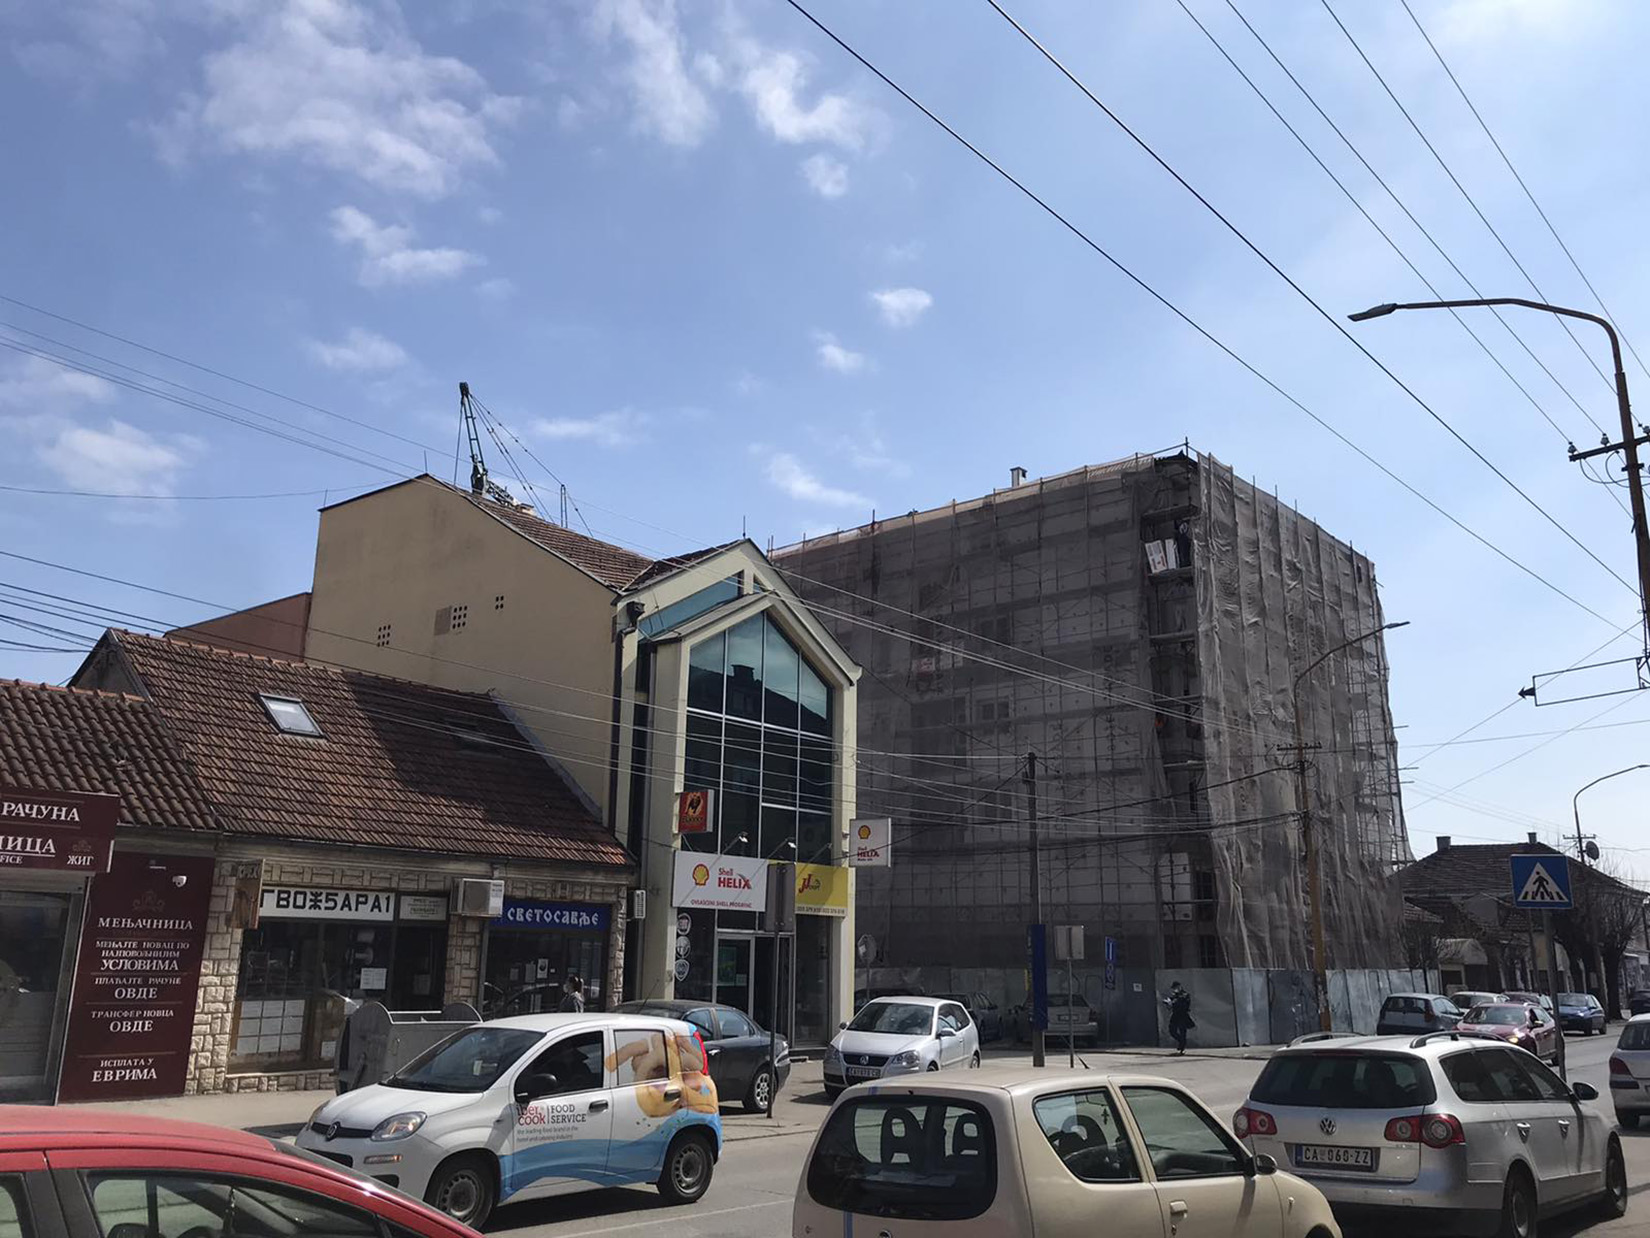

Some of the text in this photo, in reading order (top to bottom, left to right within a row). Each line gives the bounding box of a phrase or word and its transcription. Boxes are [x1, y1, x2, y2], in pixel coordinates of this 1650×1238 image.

[1, 801, 80, 821] РАЧУНА
[66, 855, 94, 866] ЖИГ
[718, 867, 734, 876] Shell
[717, 875, 752, 890] HELIX
[98, 917, 193, 930] МЕЊАЧНИЦА
[100, 959, 179, 971] УСЛОВИМА
[114, 987, 158, 1000] ОВДЕ
[91, 1010, 142, 1019] ТРАНСФЕР
[109, 1020, 154, 1033] ОВДЕ
[100, 1058, 145, 1068] ИСПЛАТА
[91, 1068, 157, 1083] ЕВРИМА
[551, 1104, 575, 1113] FOOD
[518, 1113, 546, 1126] cook
[550, 1113, 586, 1124] SERVICE
